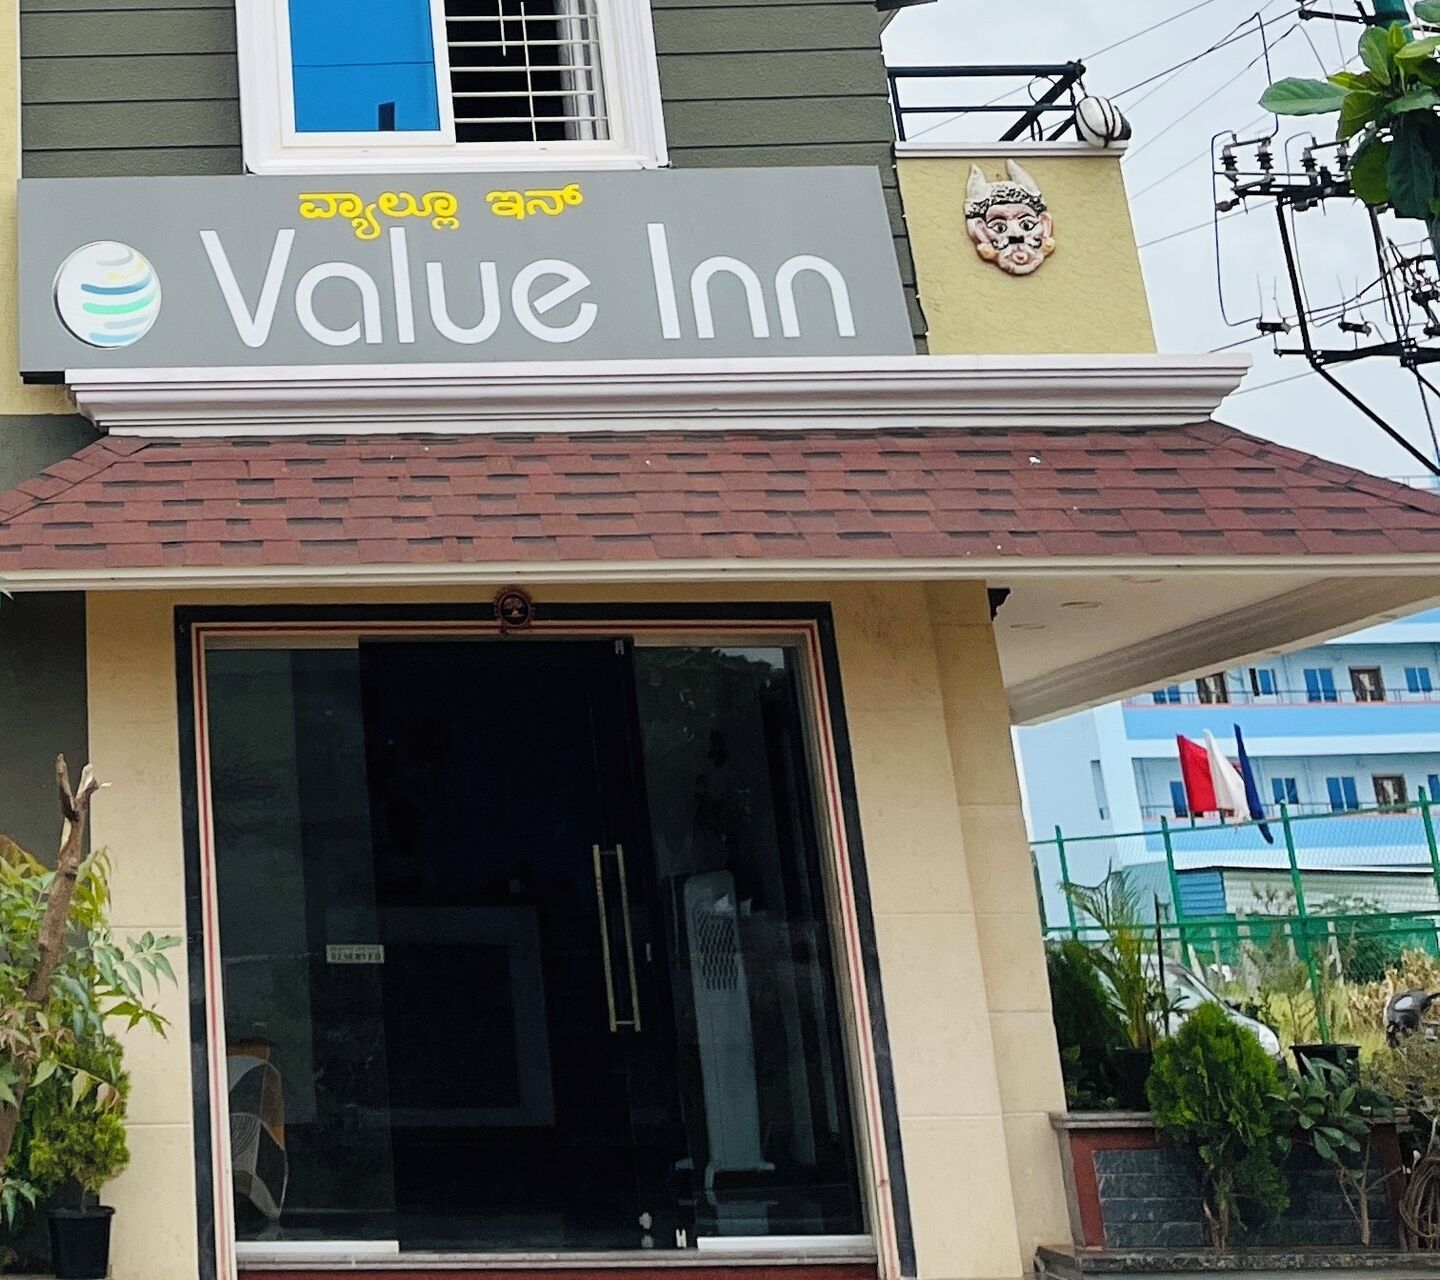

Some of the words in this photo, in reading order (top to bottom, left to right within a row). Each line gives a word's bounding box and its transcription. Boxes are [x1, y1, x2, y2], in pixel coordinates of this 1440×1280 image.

[486, 183, 584, 220] ಇನ್
[200, 227, 598, 347] Value
[647, 223, 856, 339] Inn
